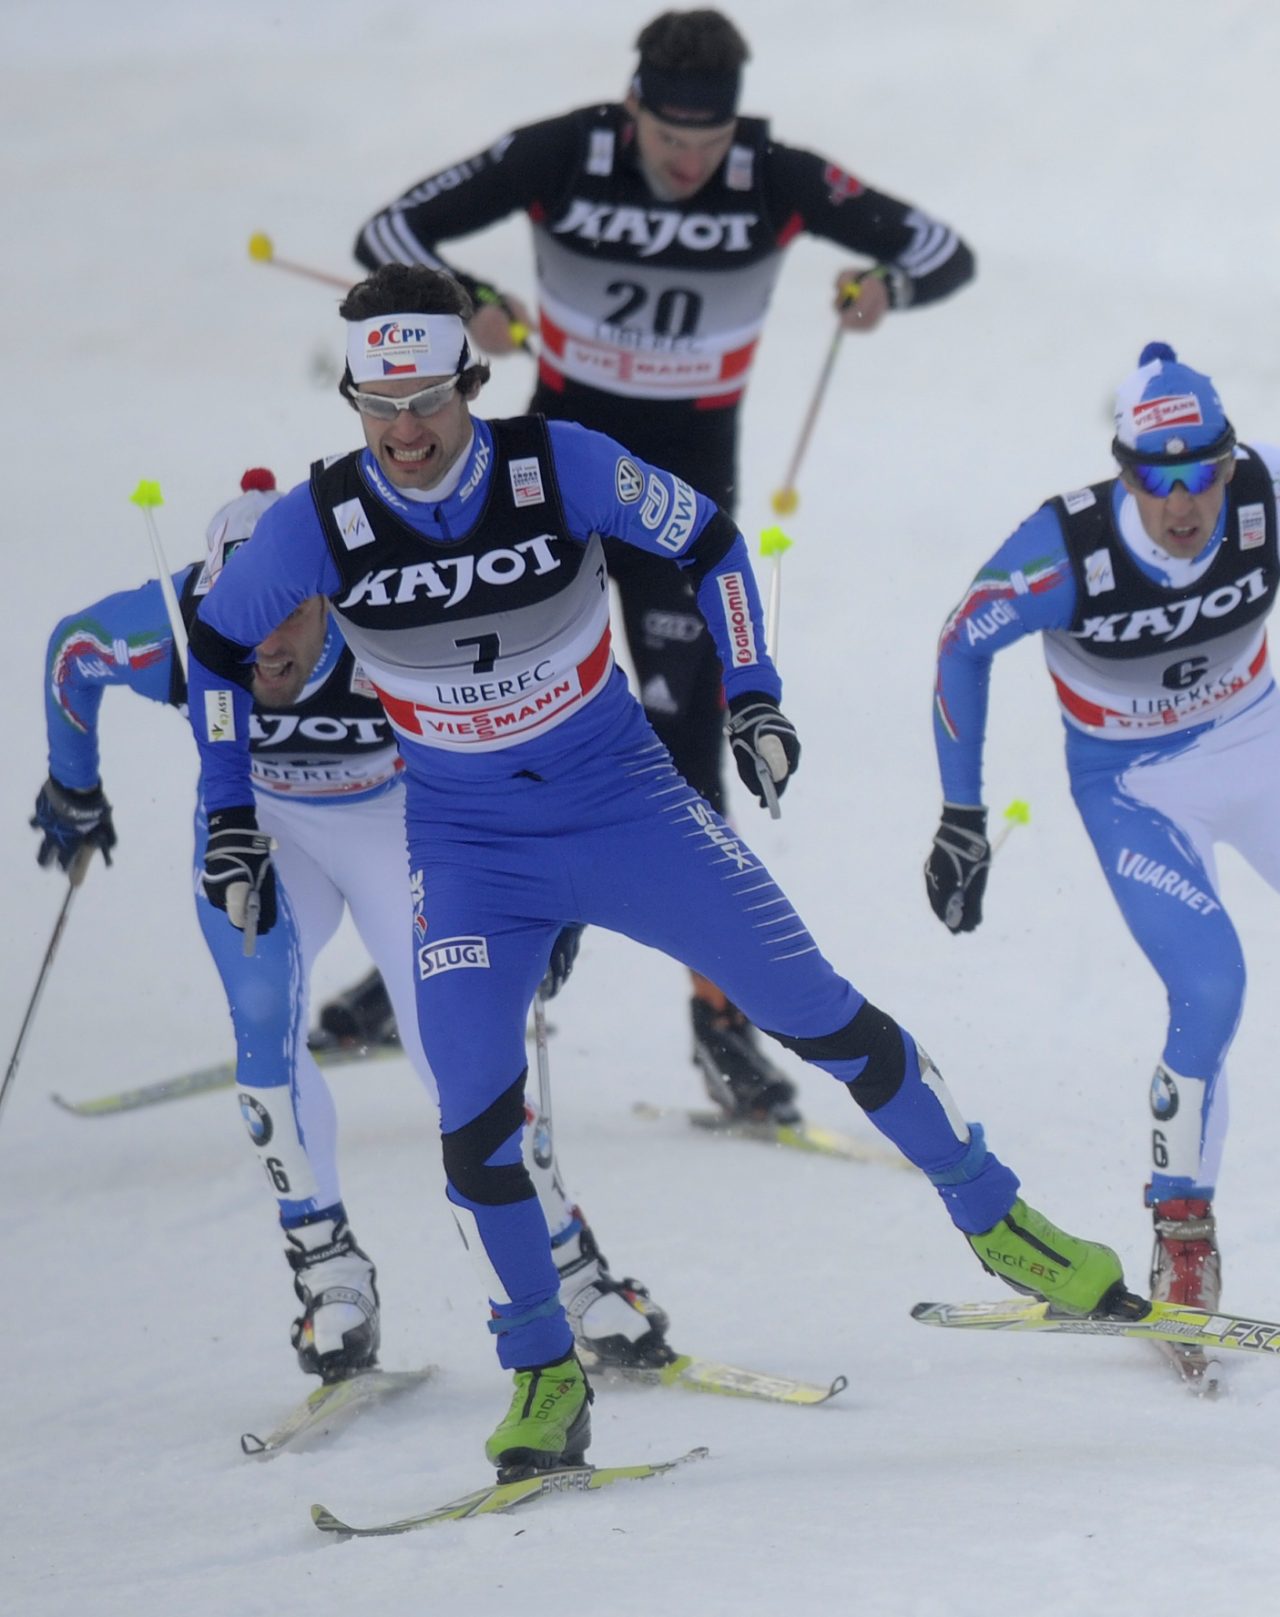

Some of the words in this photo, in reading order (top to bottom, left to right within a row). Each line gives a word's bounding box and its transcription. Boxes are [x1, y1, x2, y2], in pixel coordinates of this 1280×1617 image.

[553, 200, 758, 257] KAJOT
[388, 321, 426, 344] ČPP
[605, 279, 704, 340] 20
[663, 477, 694, 547] RWE
[337, 533, 561, 608] KAJOT
[1070, 567, 1269, 643] KAJOT
[454, 632, 501, 675] 7
[1162, 656, 1209, 690] 6
[436, 660, 556, 705] LIBEREC
[427, 680, 572, 739] VIESSMANN
[421, 939, 483, 976] SLUG
[1152, 1128, 1169, 1168] 6
